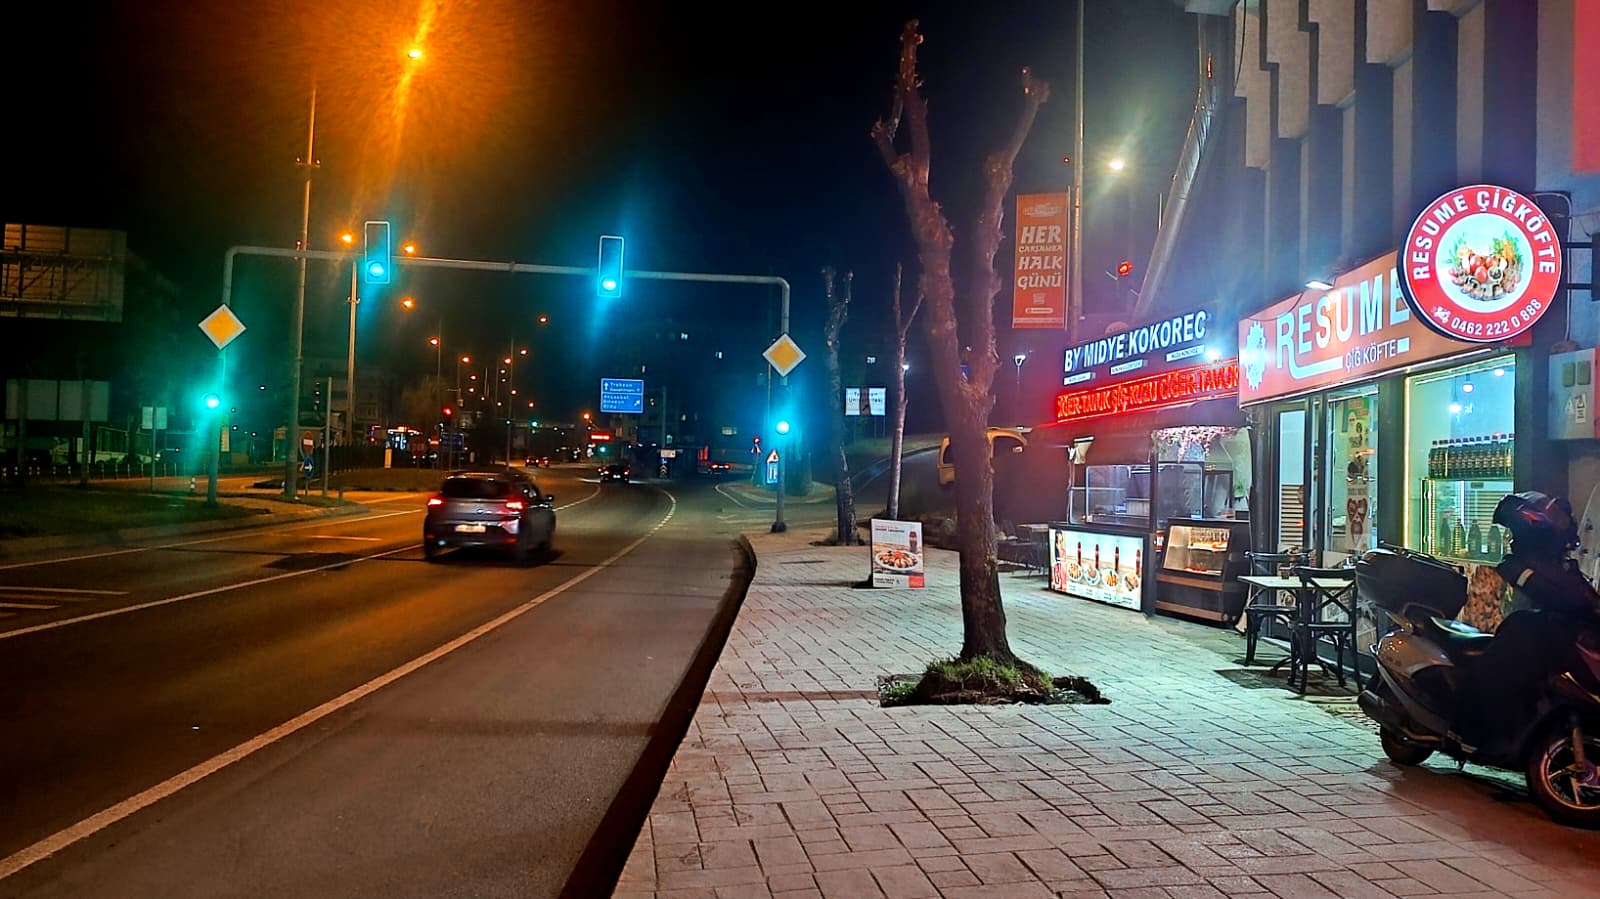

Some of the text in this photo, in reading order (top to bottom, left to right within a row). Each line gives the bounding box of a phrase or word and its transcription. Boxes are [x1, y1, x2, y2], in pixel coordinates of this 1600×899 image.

[1021, 224, 1061, 244] HER
[1413, 188, 1556, 280] RESUME ÇİĞKÖFTE
[1018, 255, 1062, 270] HALK
[1017, 271, 1061, 290] GÜNÜ
[1276, 267, 1411, 371] RESUME
[1451, 298, 1543, 337] 0462 222 0 888
[1064, 346, 1082, 373] BY
[1363, 339, 1397, 365] KÖFTE
